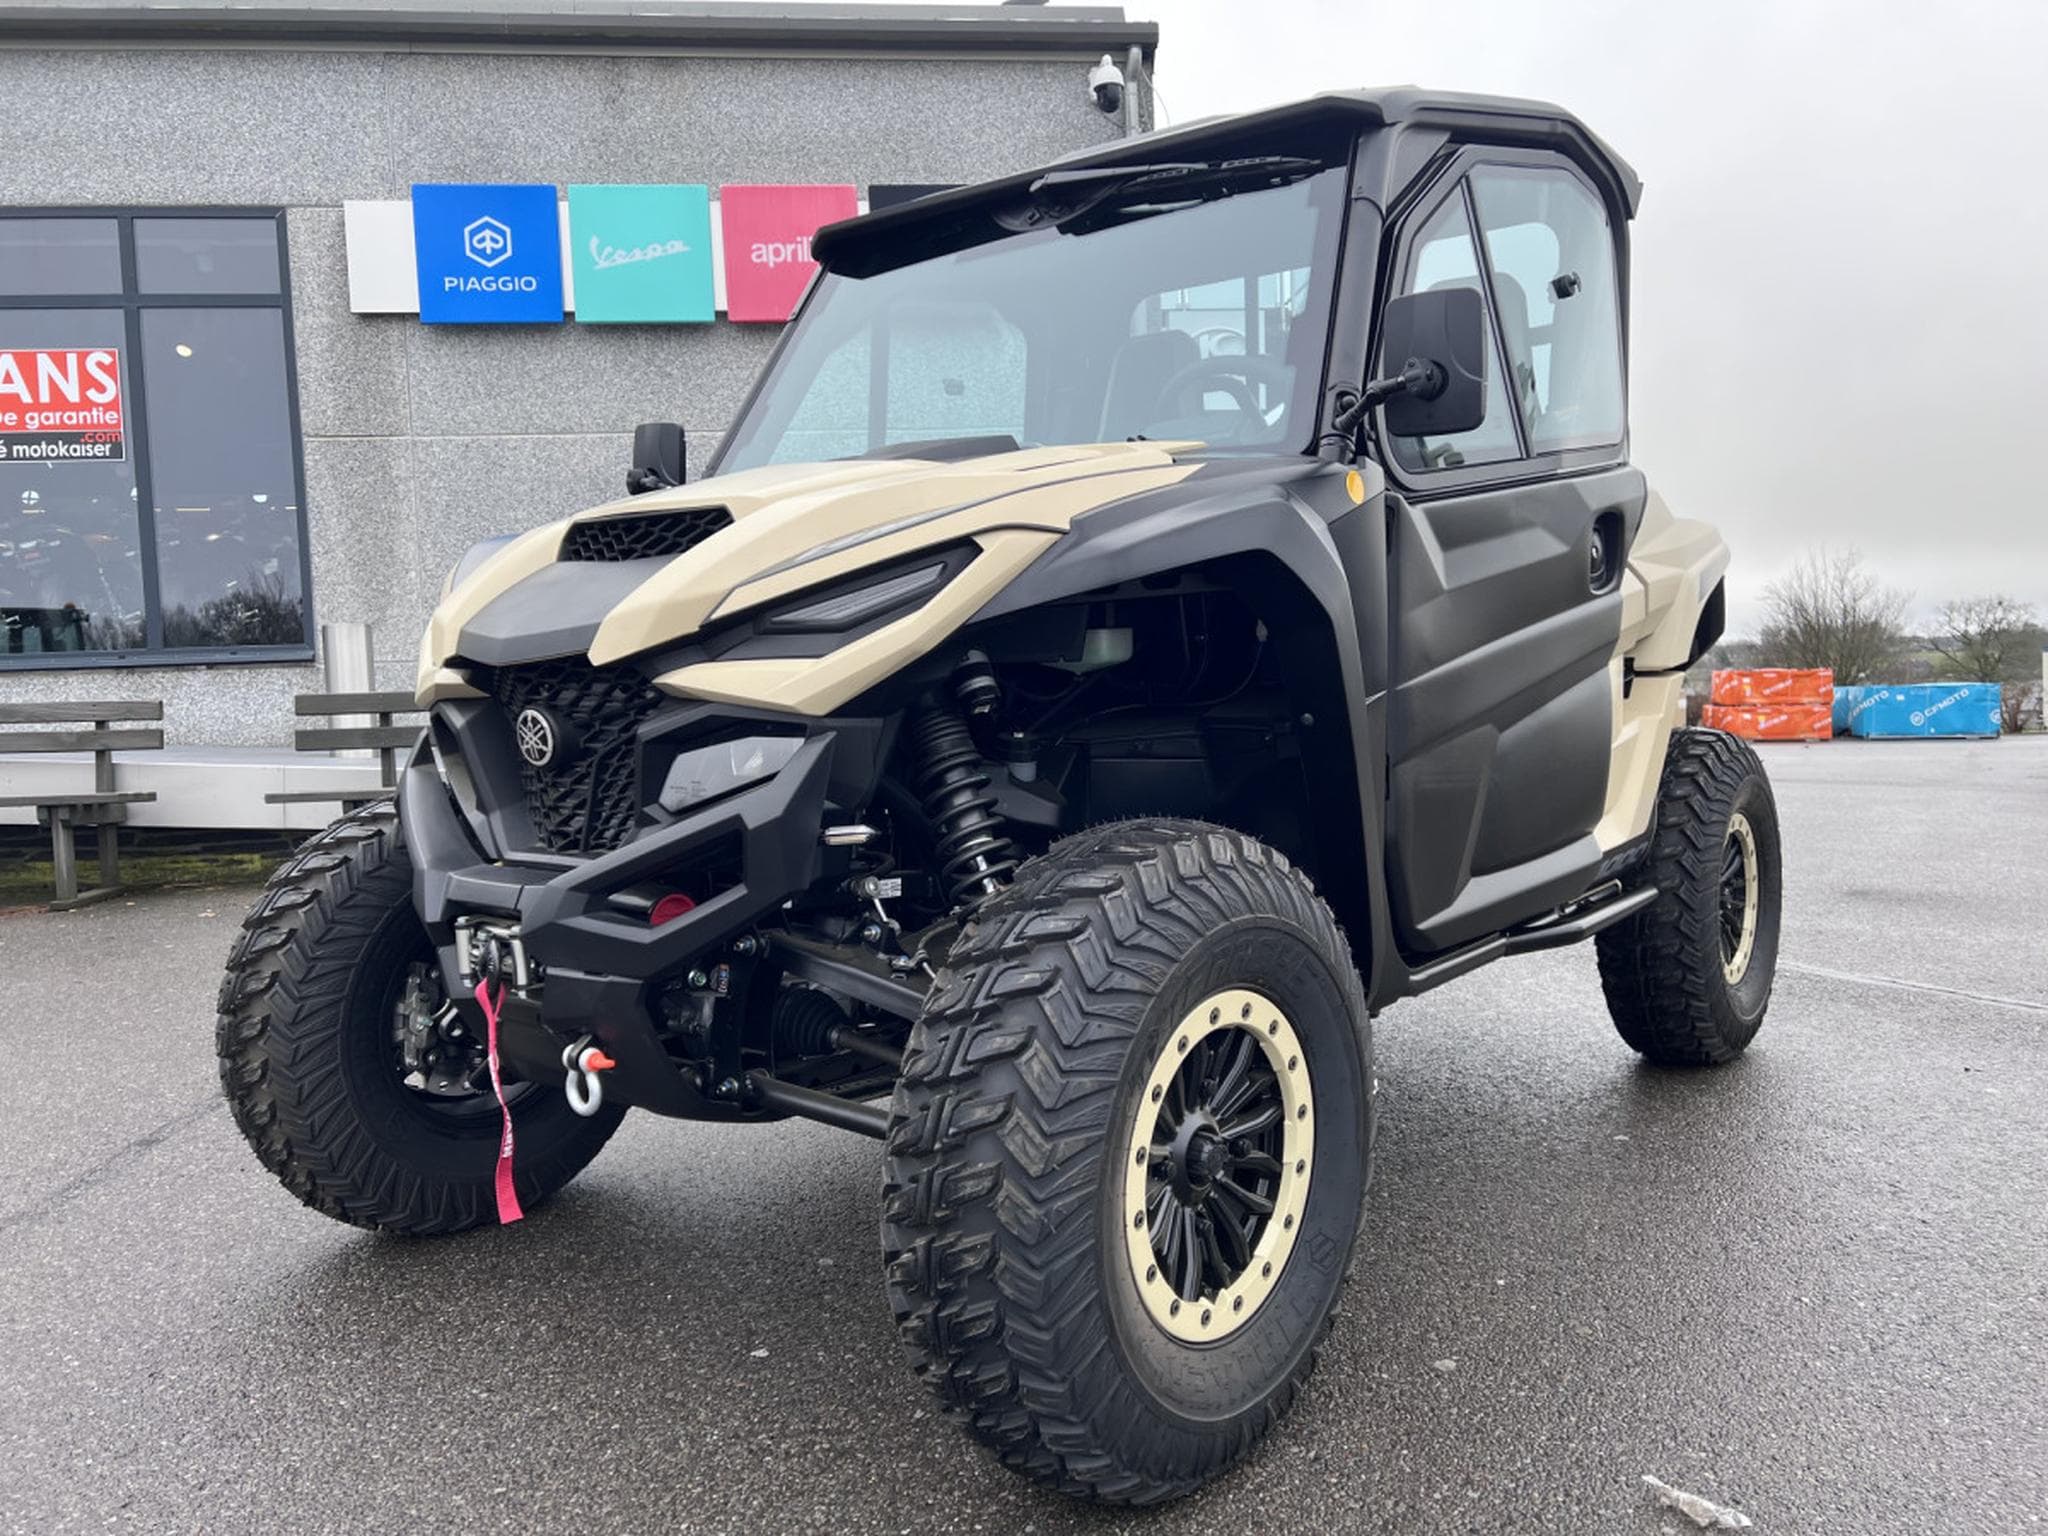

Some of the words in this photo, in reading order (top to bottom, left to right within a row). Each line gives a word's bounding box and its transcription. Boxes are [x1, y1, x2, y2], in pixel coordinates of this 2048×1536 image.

[589, 234, 691, 270] Vespa
[751, 236, 815, 267] aprili
[444, 276, 537, 292] PIAGGIO
[0, 351, 117, 404] ANS
[25, 406, 119, 429] garantie
[12, 440, 112, 458] motokaiser
[80, 432, 121, 442] .com
[1924, 688, 1969, 717] CFMOTO
